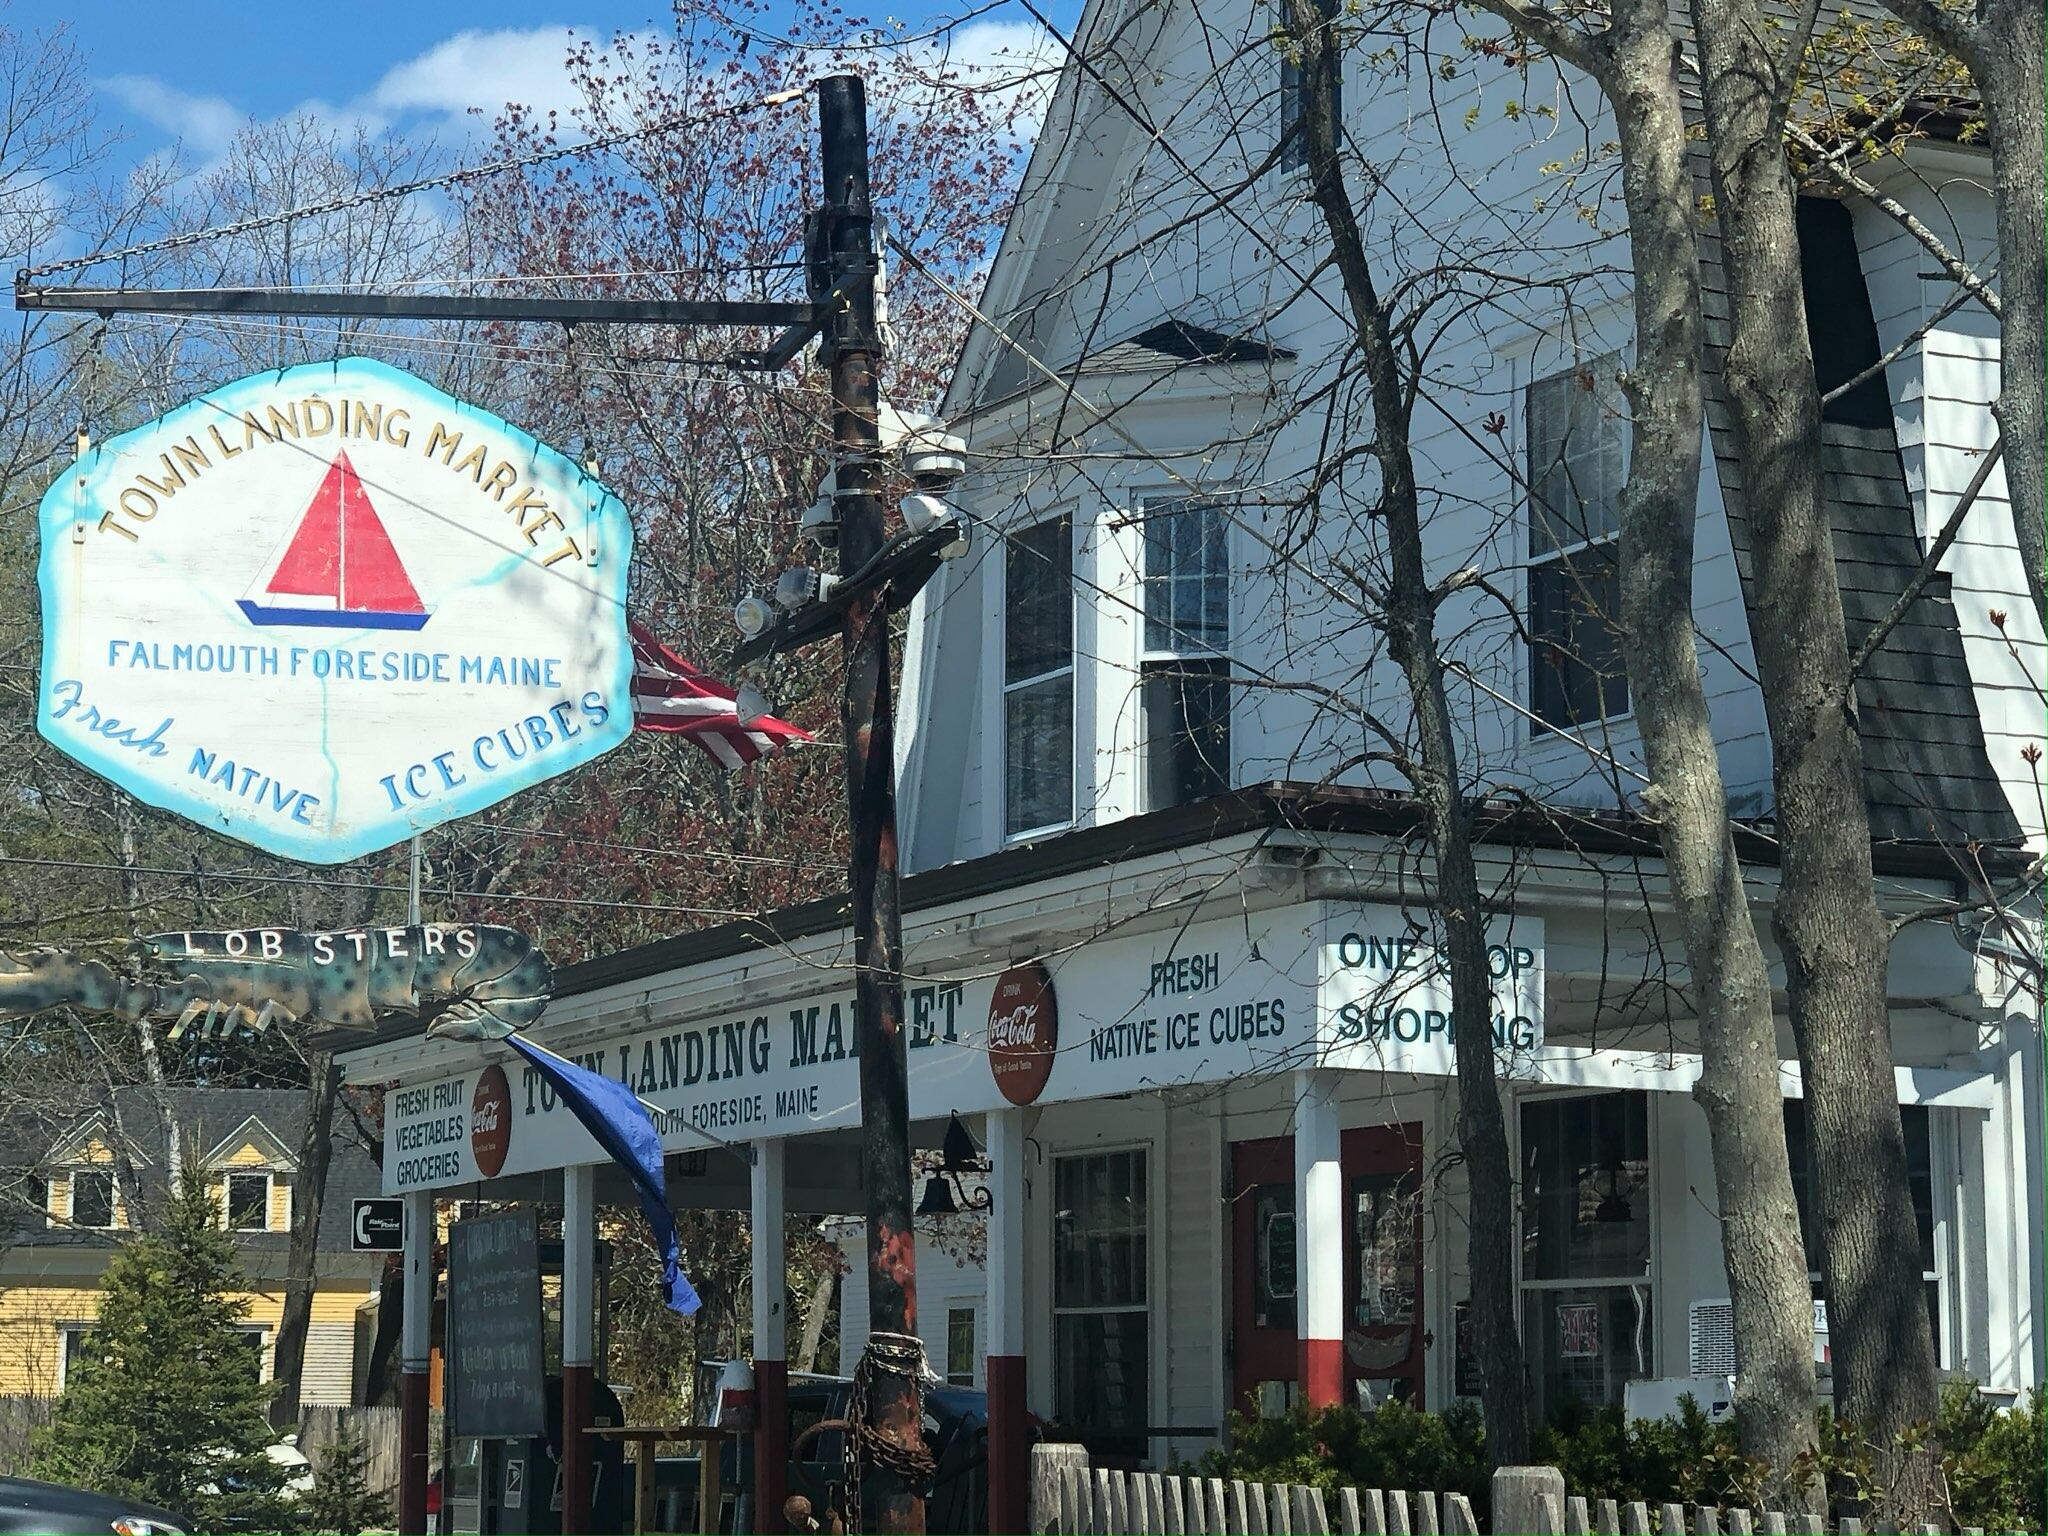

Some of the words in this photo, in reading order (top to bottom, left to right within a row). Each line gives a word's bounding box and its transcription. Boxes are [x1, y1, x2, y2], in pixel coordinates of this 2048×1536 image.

[98, 435, 213, 543] TOWN
[207, 399, 411, 460] LANDING
[424, 422, 582, 567] MARKET
[108, 640, 278, 675] FALMOUTH
[290, 647, 450, 682] FORESIDE
[460, 655, 562, 688] MAINE
[50, 680, 175, 757] Fresh
[187, 748, 320, 825] NATIVE
[379, 751, 467, 812] ICE
[473, 692, 609, 772] CUBES
[1151, 952, 1219, 998] FRESH
[1339, 932, 1418, 972] ONE
[1437, 941, 1535, 980] SOP
[619, 1015, 771, 1096] LANDING
[789, 981, 963, 1068] MAET
[988, 1004, 1039, 1049] Coca-Cola
[1090, 1018, 1157, 1062] NATIVE
[1166, 1012, 1200, 1051] ICE
[1209, 998, 1285, 1045] CUBES
[1339, 1004, 1534, 1051] SHOPNG
[395, 1085, 430, 1119] FRESH
[433, 1079, 465, 1111] FRUIT
[692, 1095, 767, 1130] FORESIDE,
[775, 1085, 819, 1118] MAINE
[396, 1114, 464, 1152] VEGETABLES
[397, 1150, 460, 1186] GROCERIES
